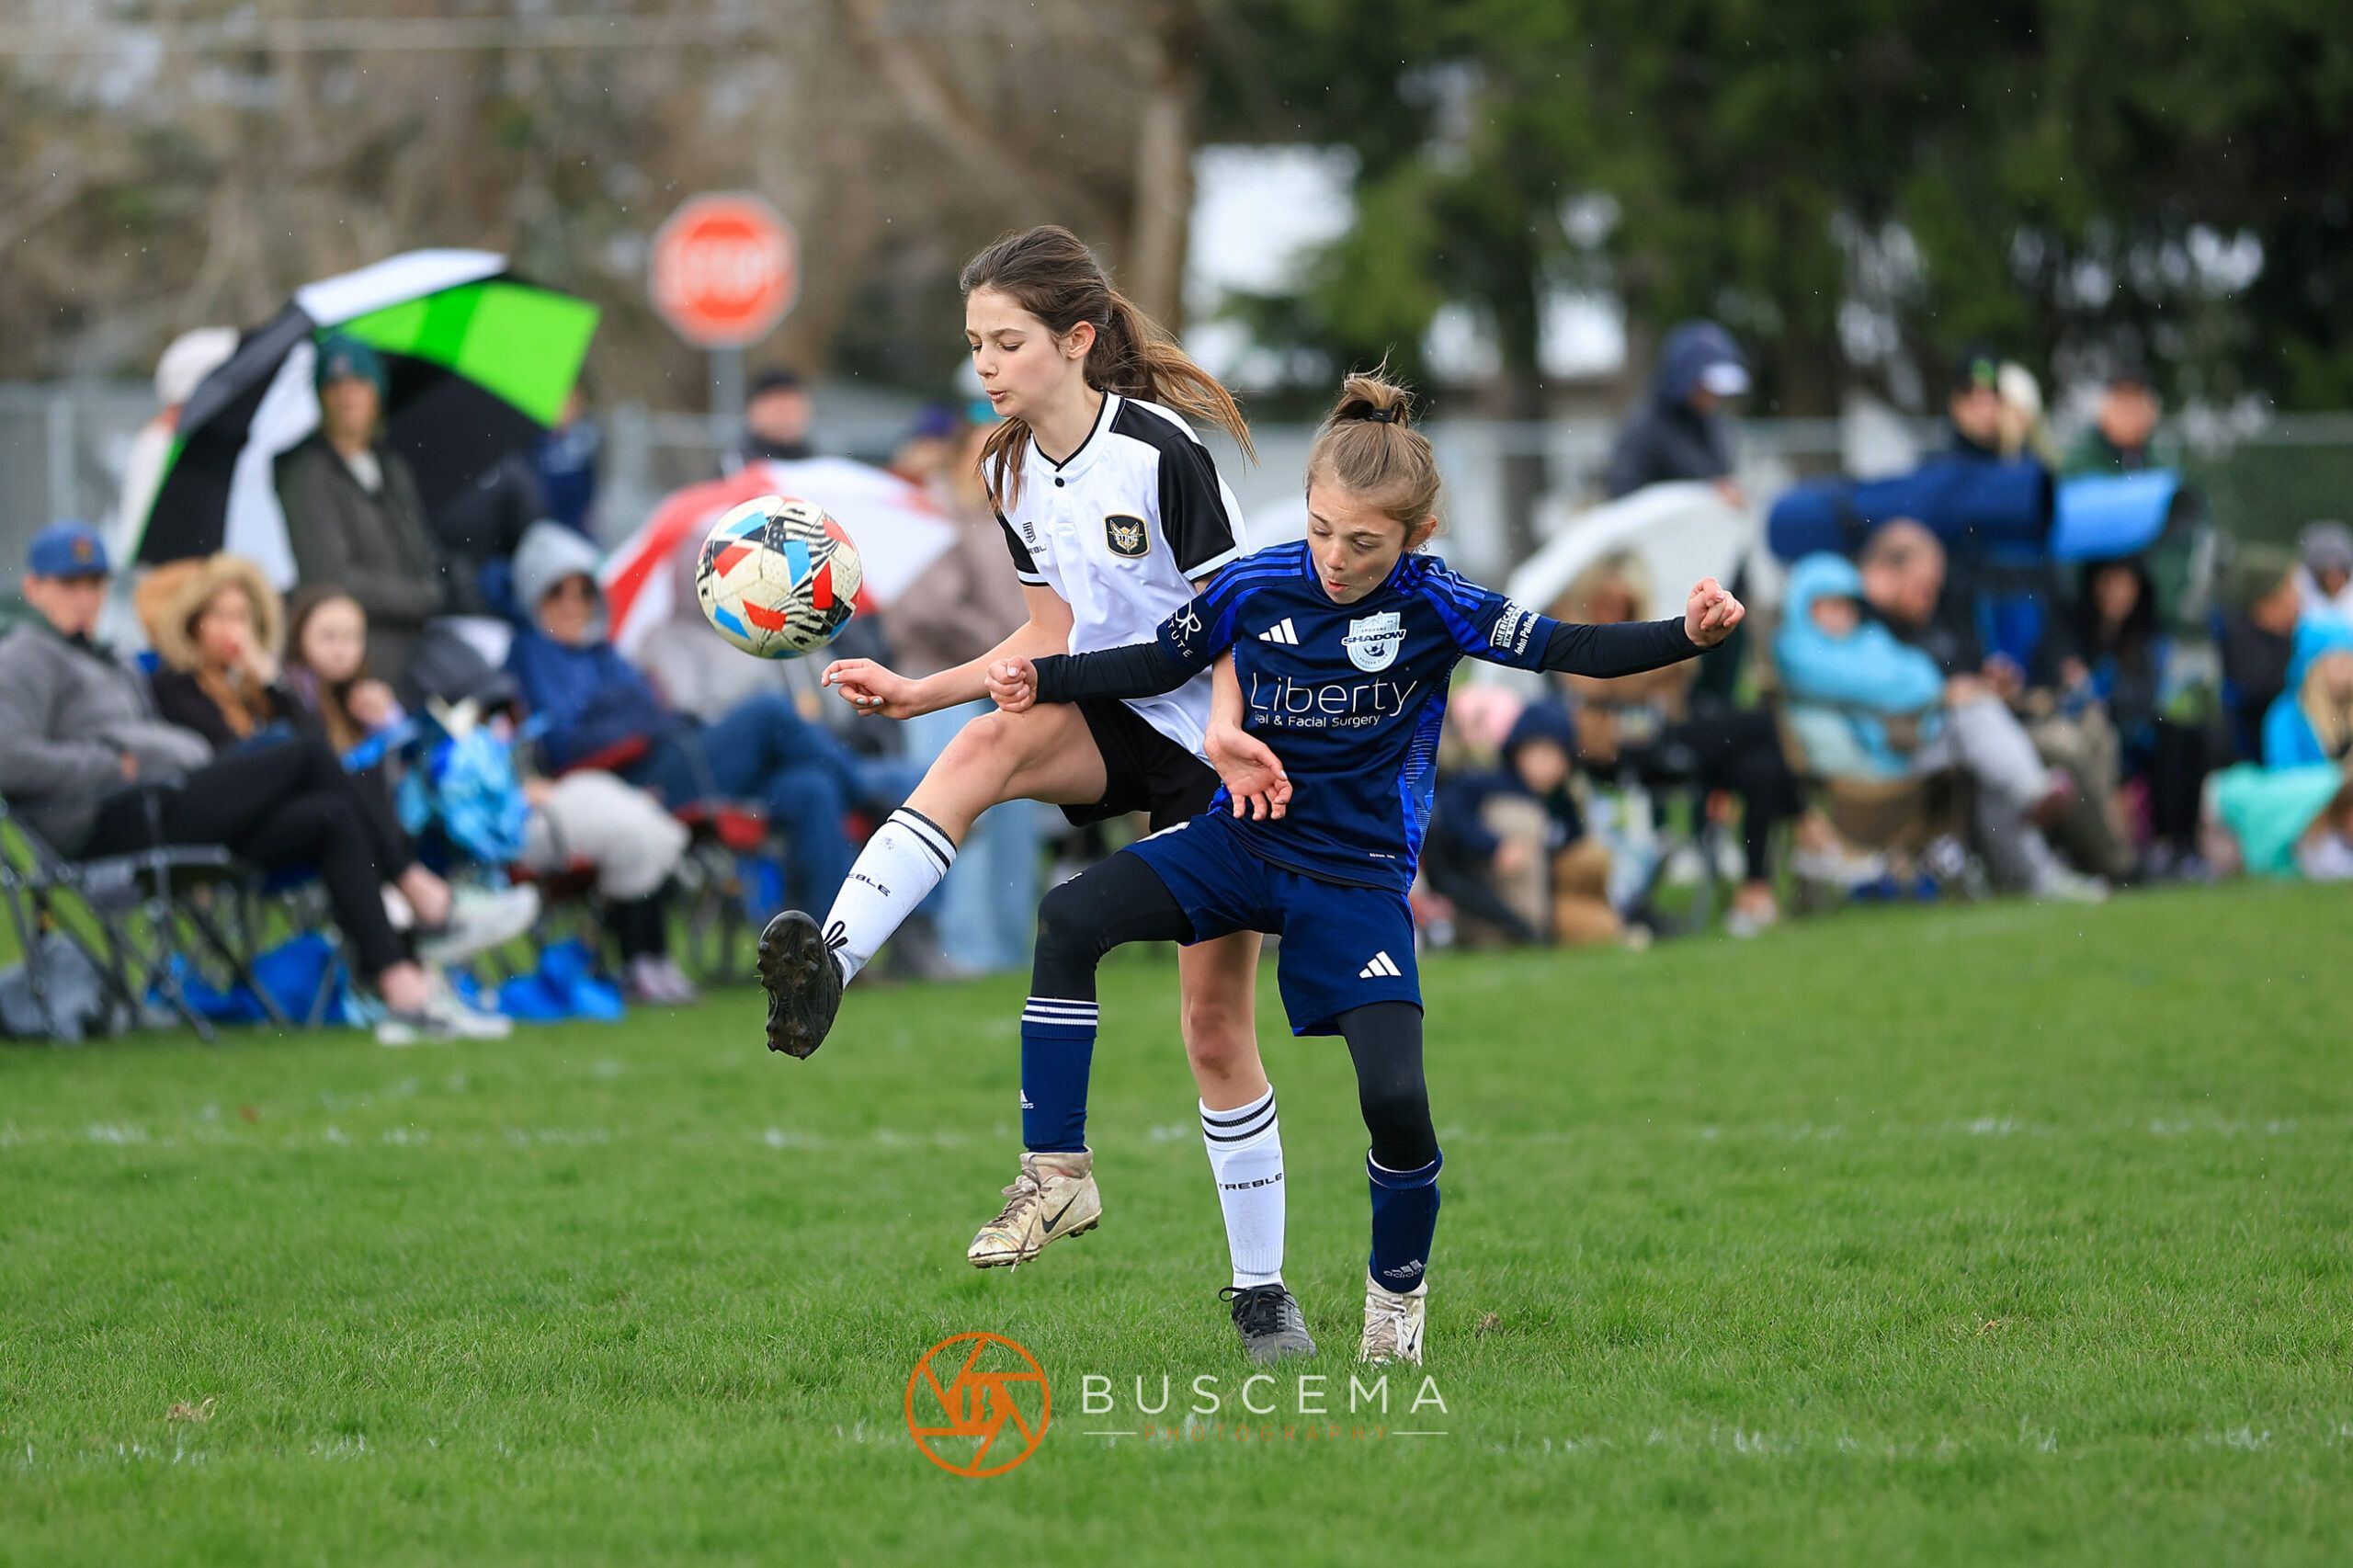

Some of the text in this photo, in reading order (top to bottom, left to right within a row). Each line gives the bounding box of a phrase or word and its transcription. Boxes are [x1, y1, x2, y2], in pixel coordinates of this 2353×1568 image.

[1028, 543, 1047, 555] EBL
[1342, 630, 1406, 645] SHADOW
[1250, 672, 1418, 717] Liberty
[1273, 714, 1283, 726] &
[1288, 715, 1326, 728] Facial
[1332, 714, 1381, 729] Surgery
